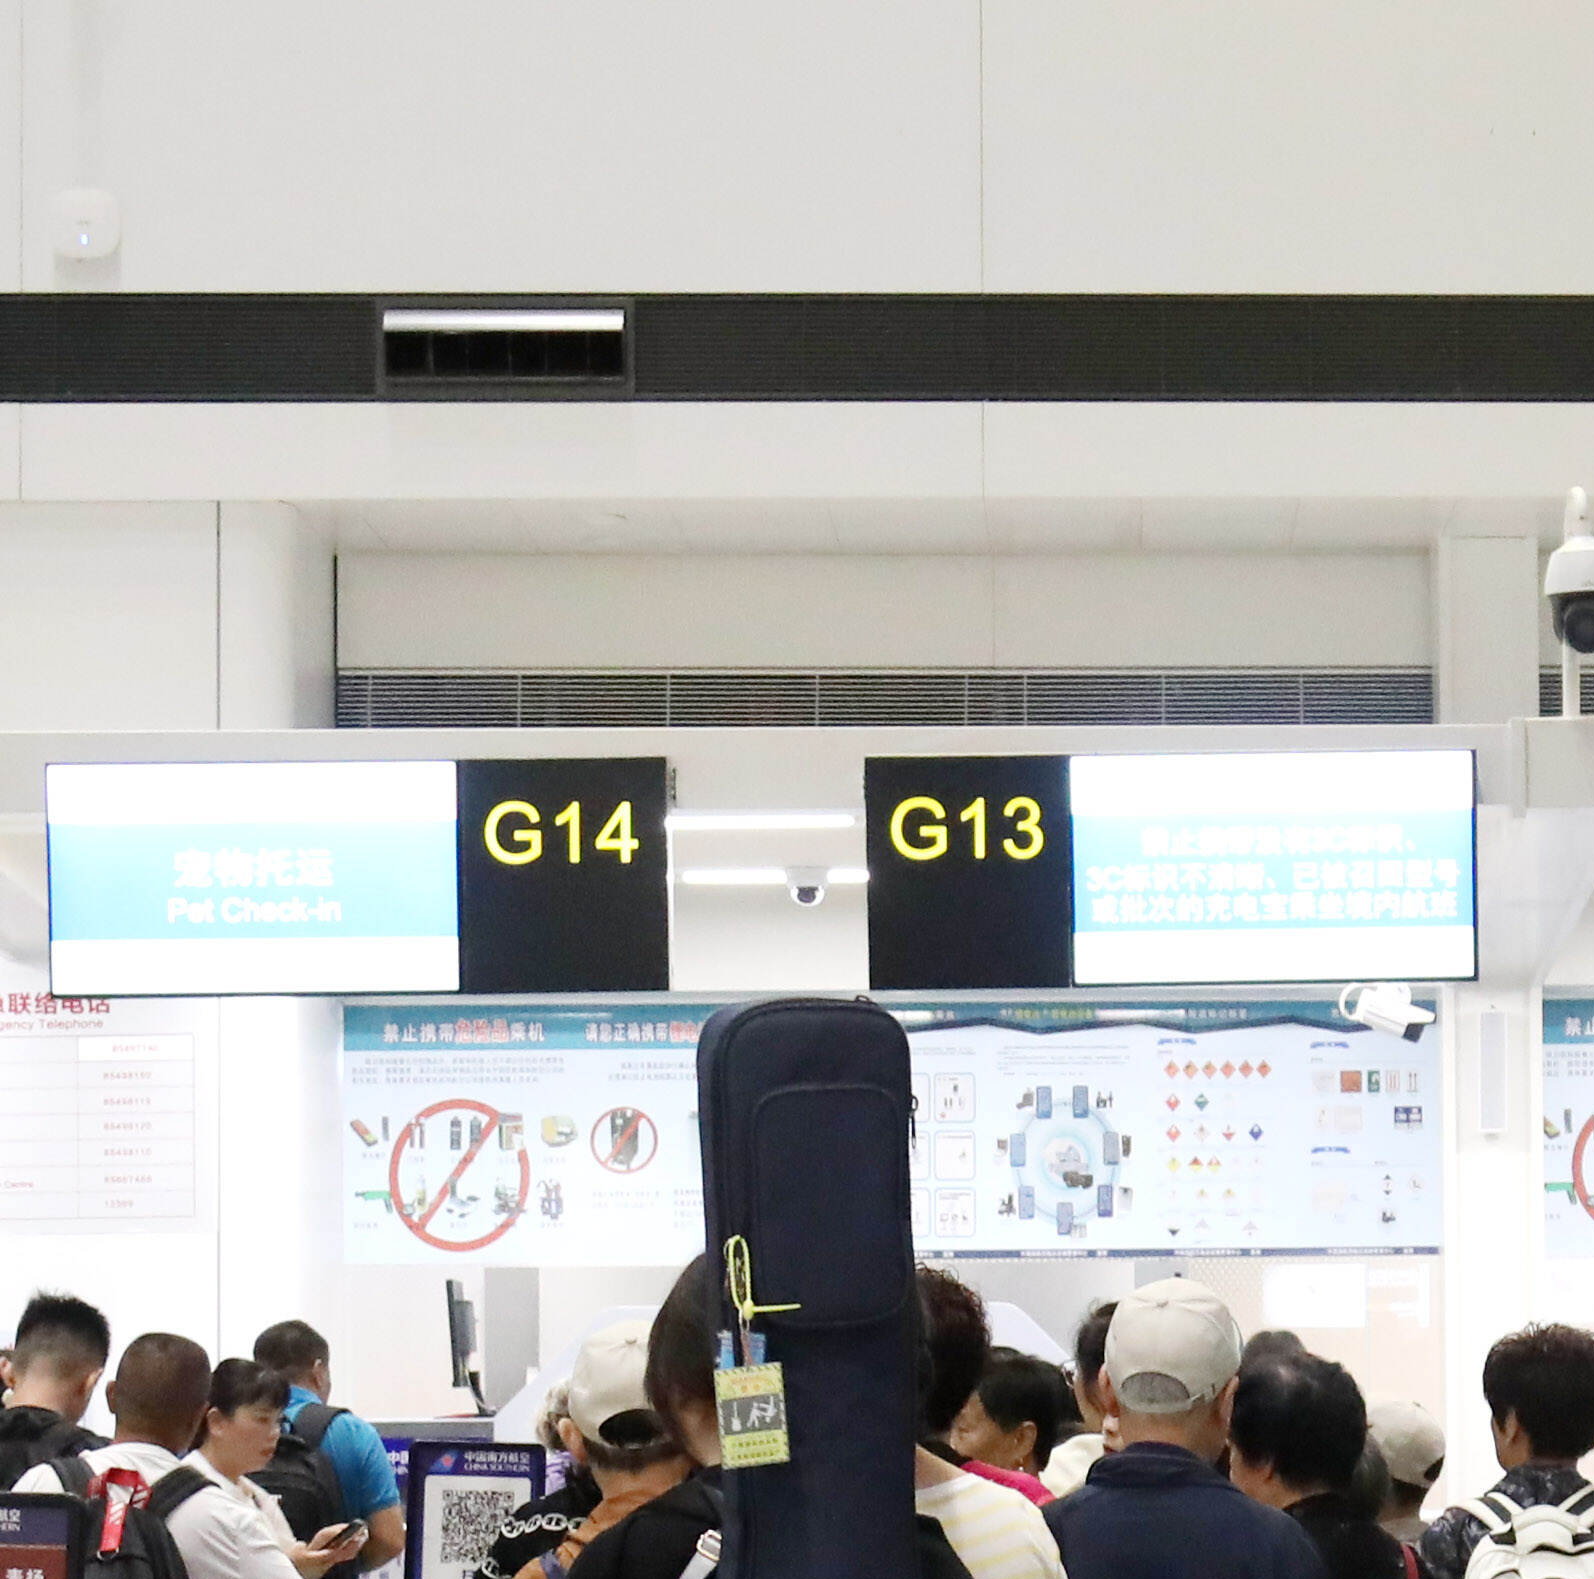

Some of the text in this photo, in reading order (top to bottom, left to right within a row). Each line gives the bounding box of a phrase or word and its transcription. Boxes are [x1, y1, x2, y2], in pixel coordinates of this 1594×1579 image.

[484, 801, 639, 865] G14
[890, 797, 1043, 860] G13
[173, 848, 334, 888] 宠物托运
[167, 896, 342, 924] Pet Check-in
[39, 1018, 104, 1029] Telephone
[383, 1019, 545, 1043] 禁止携带危险品乘机
[464, 1451, 531, 1464] 中国南方航空
